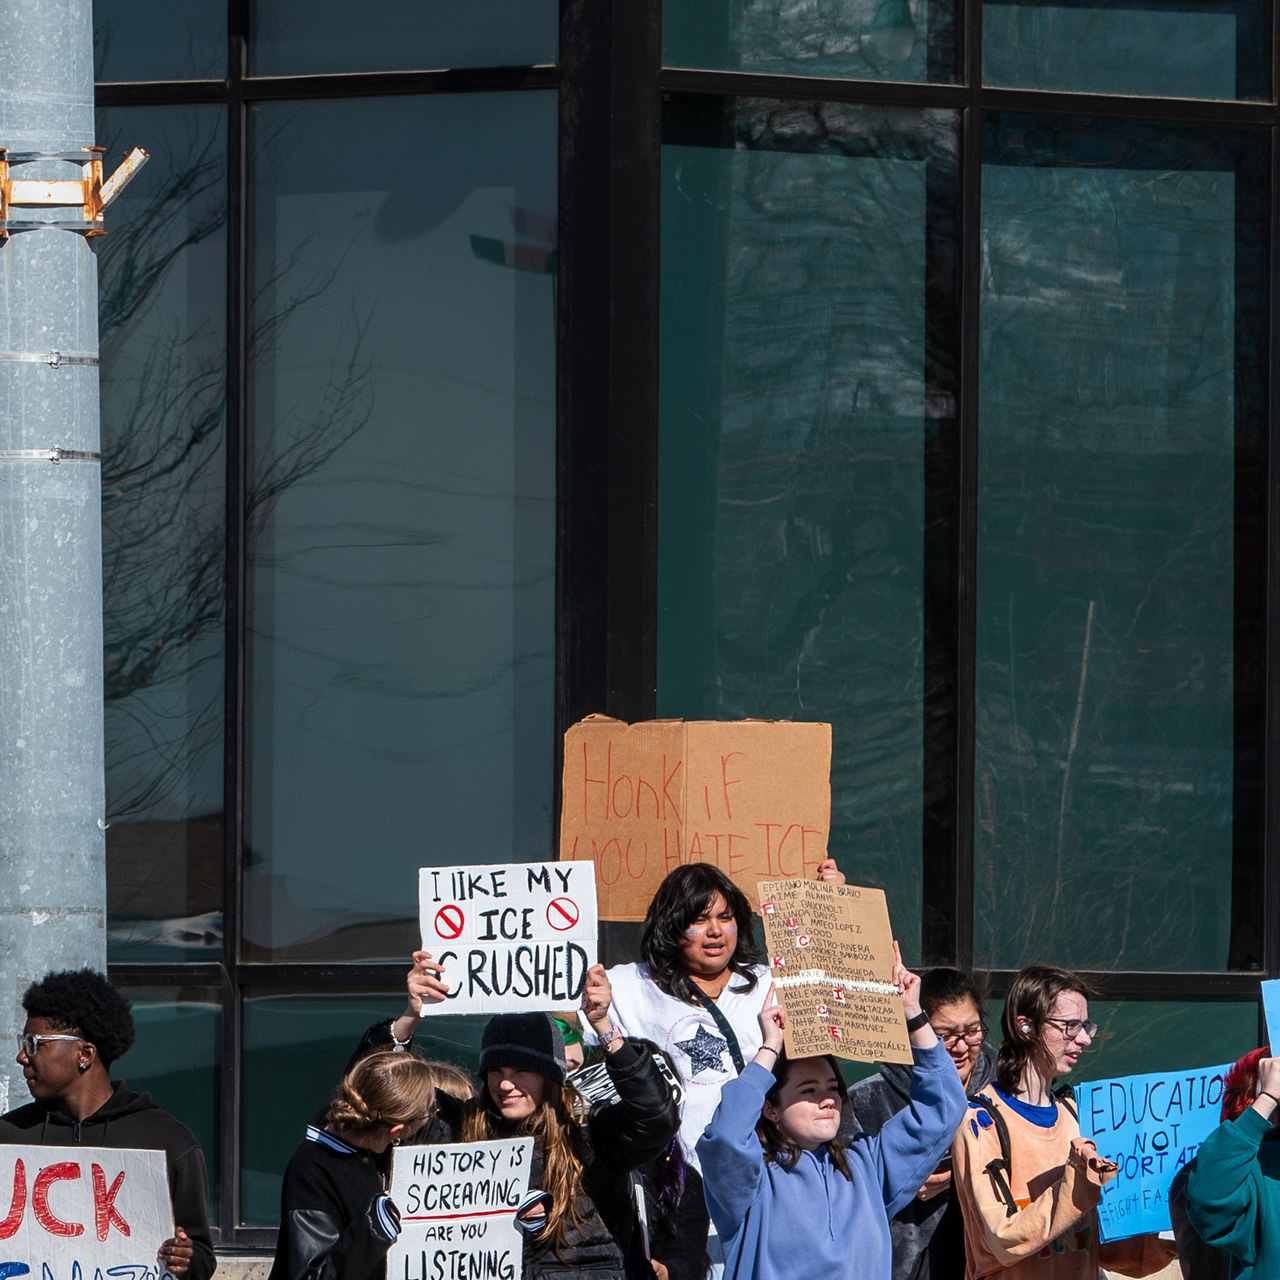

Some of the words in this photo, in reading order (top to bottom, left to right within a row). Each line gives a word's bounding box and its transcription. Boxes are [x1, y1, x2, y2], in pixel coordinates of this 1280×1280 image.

[664, 828, 749, 877] HATE
[431, 871, 442, 902] I
[526, 866, 573, 893] MY
[803, 881, 834, 894] MOLINA
[764, 891, 798, 903] JAIME
[805, 890, 835, 903] ALANIS
[761, 901, 795, 916] FELIX
[768, 911, 781, 921] DR
[783, 909, 810, 920] LINDA
[813, 910, 838, 921] DAVIS
[477, 907, 534, 940] ICE
[769, 917, 807, 930] MANUEL
[810, 918, 834, 930] MATEO
[835, 922, 863, 934] LOPEZ
[771, 928, 800, 939] RENEE
[805, 926, 833, 939] GOOD
[773, 939, 795, 949] JOSE
[772, 955, 806, 968] KEITH
[811, 955, 845, 966] PORTER
[779, 964, 802, 974] RYAN
[435, 940, 588, 1001] CRUSHED
[787, 1007, 817, 1017] ROBERTO
[789, 1017, 817, 1029] YAHIR
[792, 1027, 817, 1037] ALEX
[794, 1043, 833, 1055] HECTOR
[834, 1043, 860, 1054] LOPEZ
[860, 1048, 886, 1059] LOPEZ
[1091, 1074, 1224, 1136] EDUCATIO
[1133, 1123, 1180, 1155] NOT
[413, 1149, 502, 1178] HISTORY
[406, 1178, 520, 1214] SCREAMING
[425, 1225, 454, 1242] ARE
[460, 1221, 488, 1241] YOU
